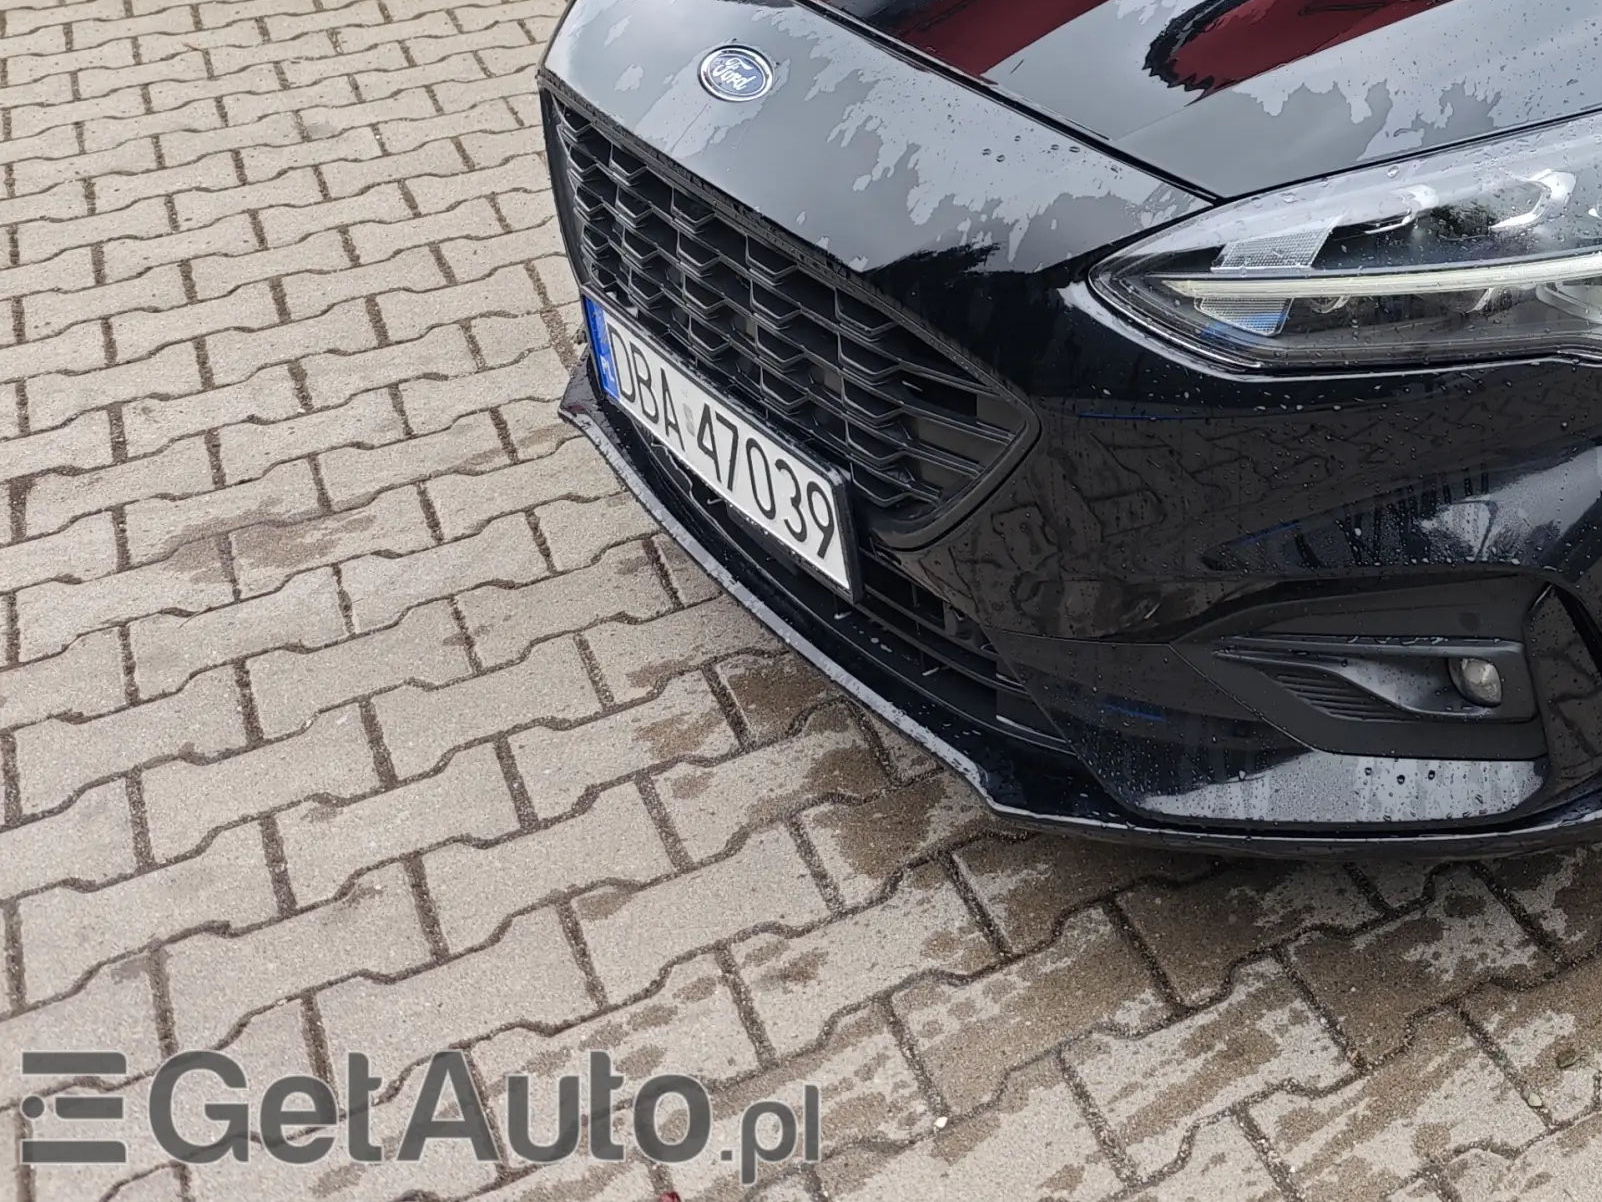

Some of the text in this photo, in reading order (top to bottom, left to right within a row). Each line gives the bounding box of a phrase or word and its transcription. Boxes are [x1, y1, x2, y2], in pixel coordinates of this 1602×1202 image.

[712, 57, 757, 91] Ford
[607, 324, 834, 559] DBA 47039
